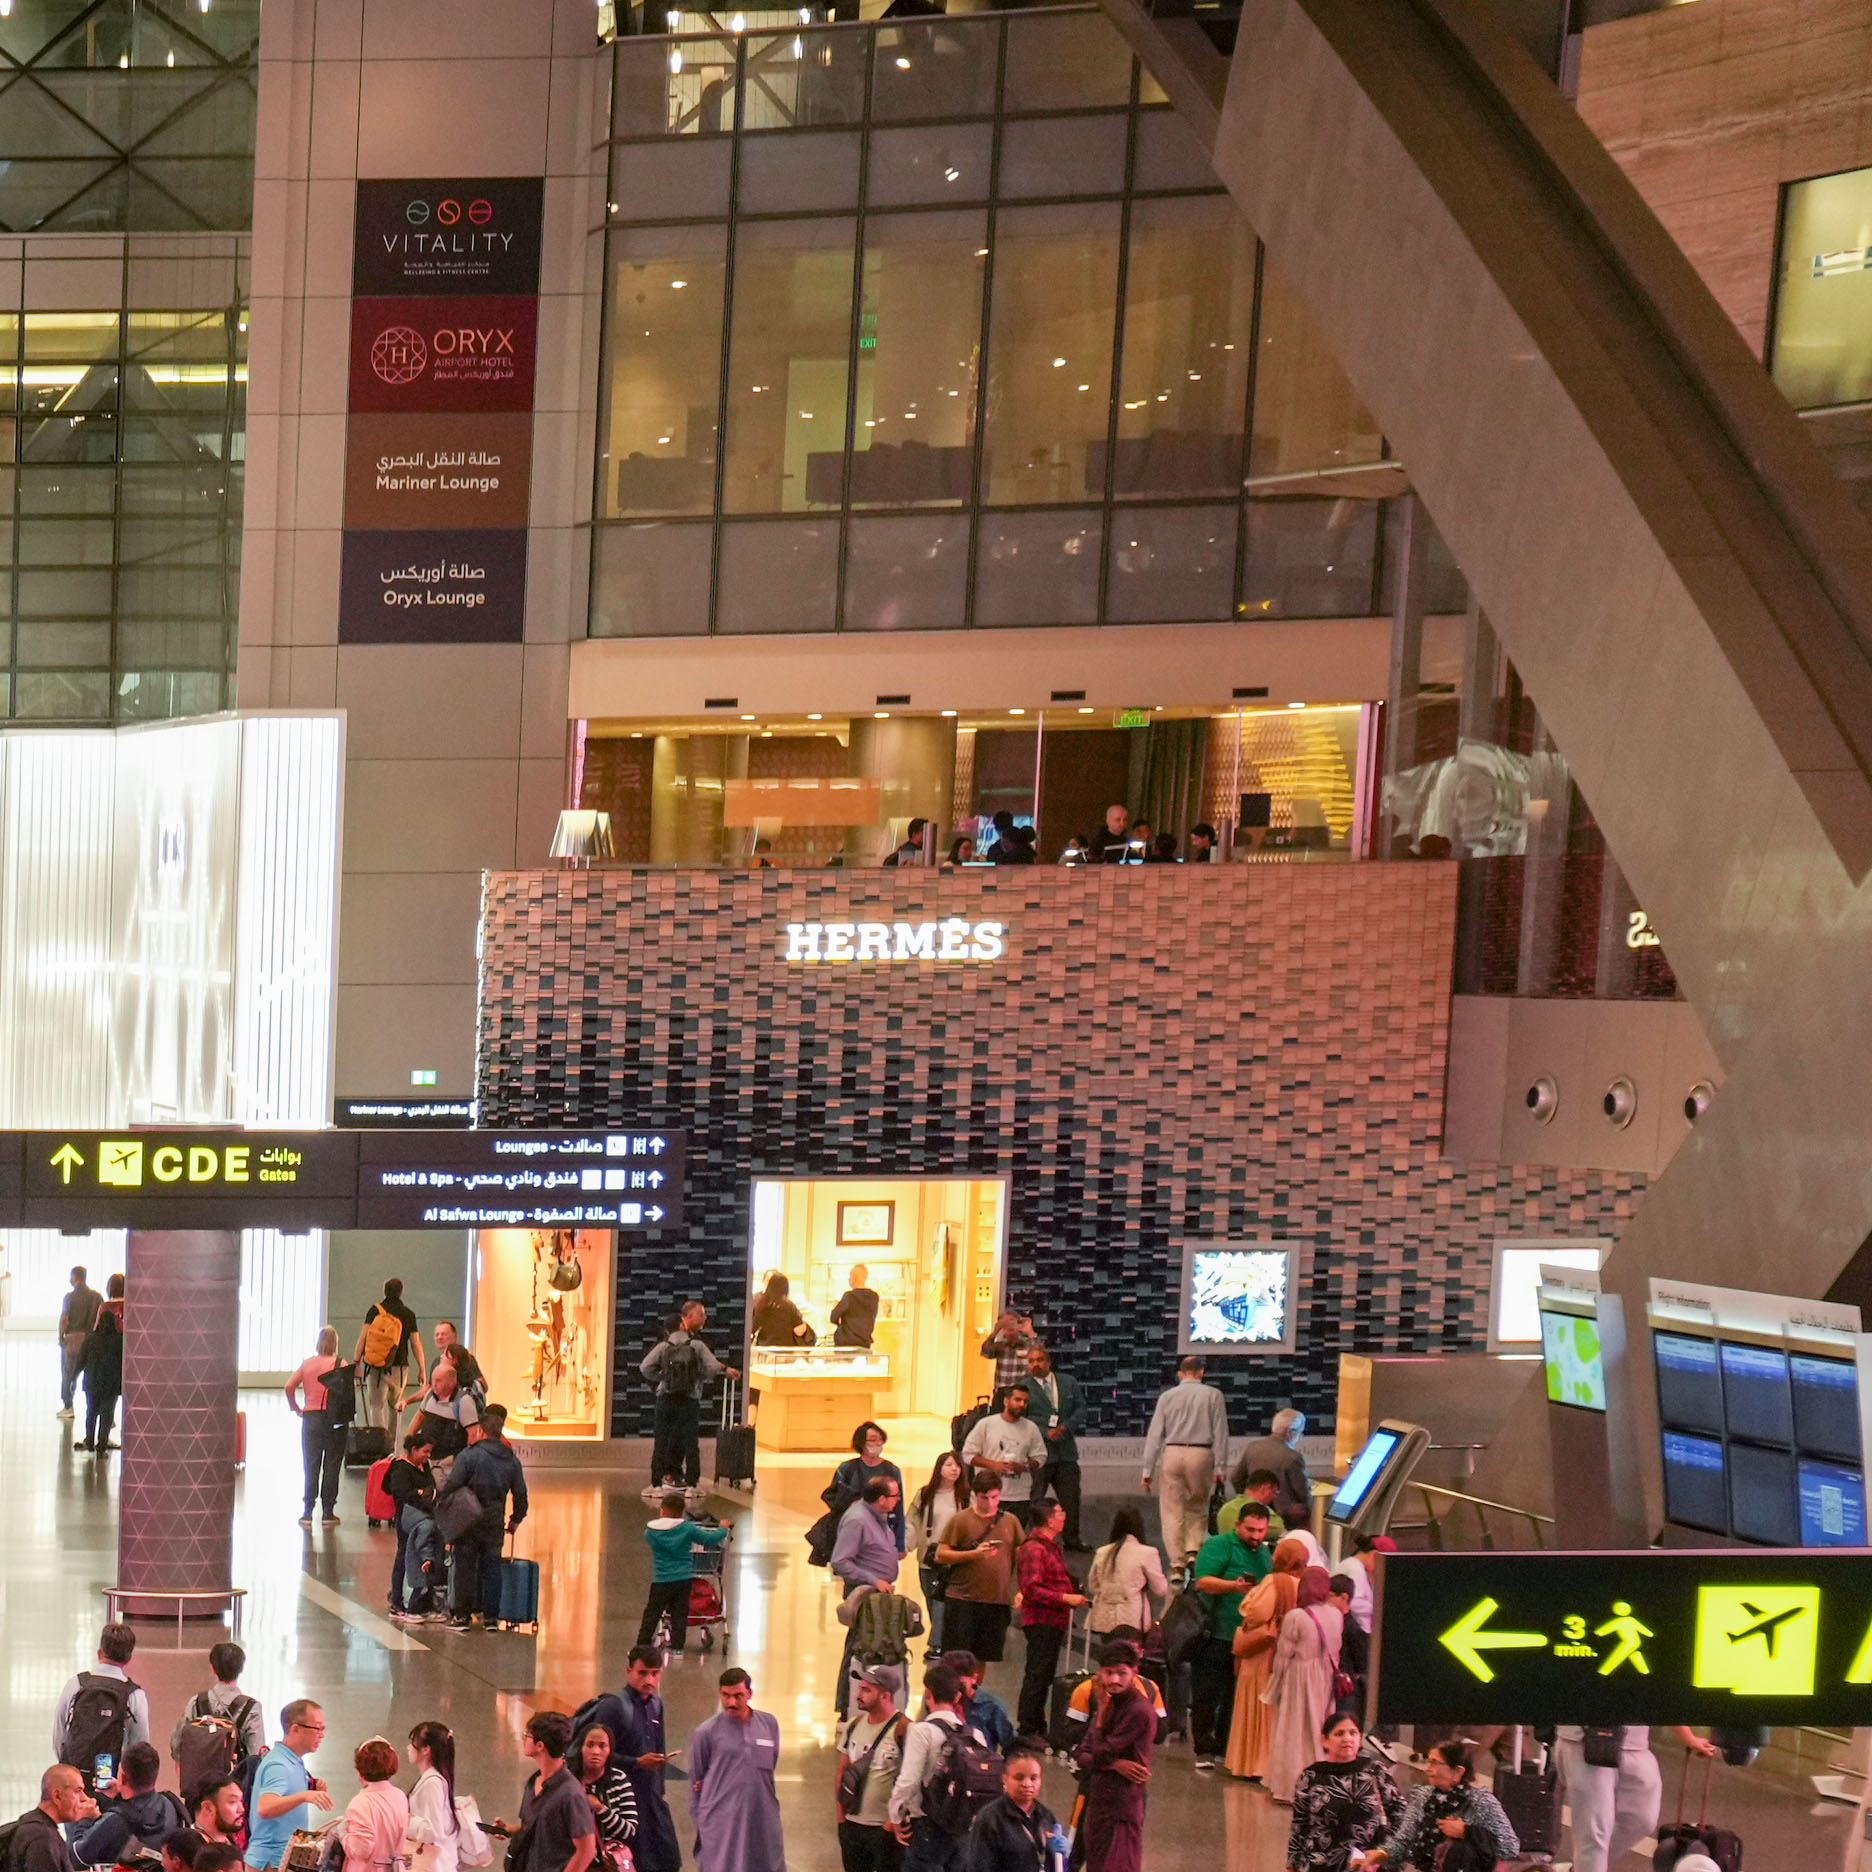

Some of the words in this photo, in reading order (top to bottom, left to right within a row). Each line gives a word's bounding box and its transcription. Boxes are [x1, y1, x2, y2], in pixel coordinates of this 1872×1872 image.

[382, 232, 514, 253] VITALITY
[433, 328, 514, 354] ORYX
[434, 357, 477, 368] AIRPORT
[480, 357, 513, 367] HOTEL
[376, 453, 424, 474] البحري
[426, 452, 465, 470] النقل
[468, 452, 501, 466] صالة
[376, 475, 437, 490] Mariner
[440, 475, 500, 492] Lounge
[380, 559, 446, 584] أوريكس
[449, 563, 486, 579] صالة
[383, 590, 422, 608] Oryx
[426, 590, 486, 608] Lounge
[496, 1140, 548, 1156] Lounges
[558, 1140, 604, 1154] صالات
[152, 1146, 250, 1182] CDE
[260, 1148, 302, 1166] بوابات
[260, 1169, 296, 1182] Gates
[382, 1172, 416, 1186] Hotel
[418, 1172, 427, 1186] &
[429, 1172, 454, 1188] Spa
[464, 1172, 503, 1190] صحي
[506, 1171, 542, 1190] ونادي
[544, 1171, 578, 1188] فندق
[424, 1208, 438, 1222] Al
[439, 1208, 478, 1222] Safwa
[480, 1208, 524, 1225] Lounge
[534, 1208, 582, 1223] الصفوة
[585, 1208, 617, 1221] صالة
[1562, 1615, 1586, 1640] 3
[1554, 1642, 1598, 1658] min.
